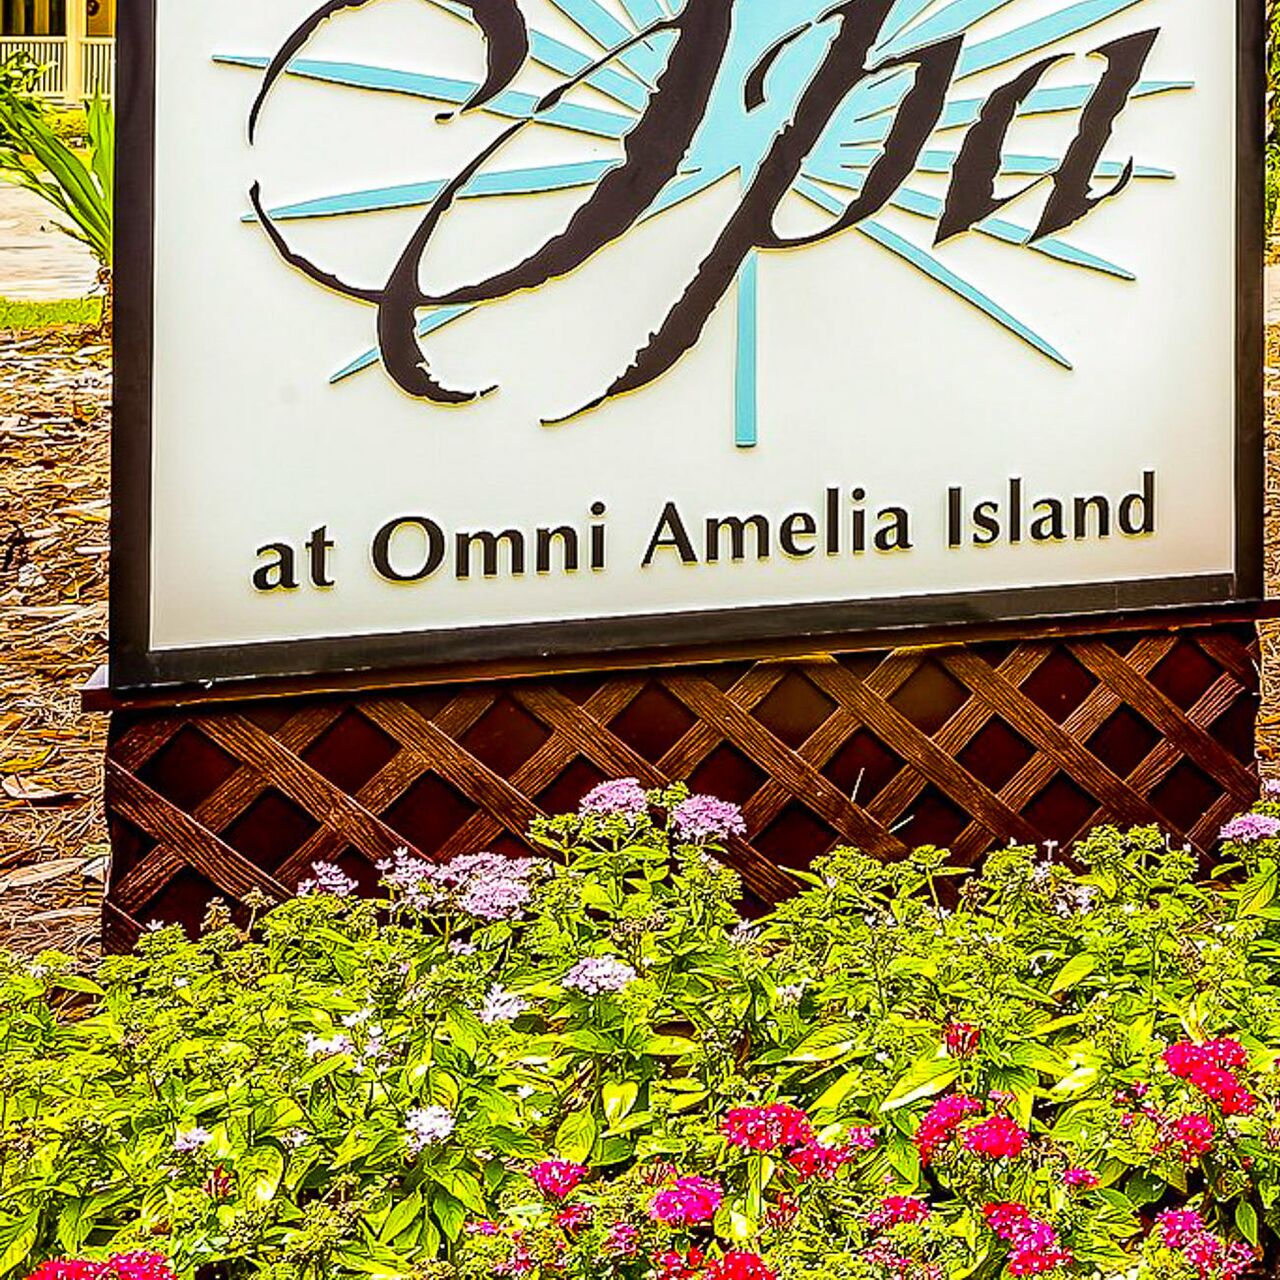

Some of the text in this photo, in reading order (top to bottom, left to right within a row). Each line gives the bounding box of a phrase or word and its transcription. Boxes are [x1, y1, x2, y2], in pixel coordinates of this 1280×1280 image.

[252, 471, 1157, 592] at Omni Amelia Island
